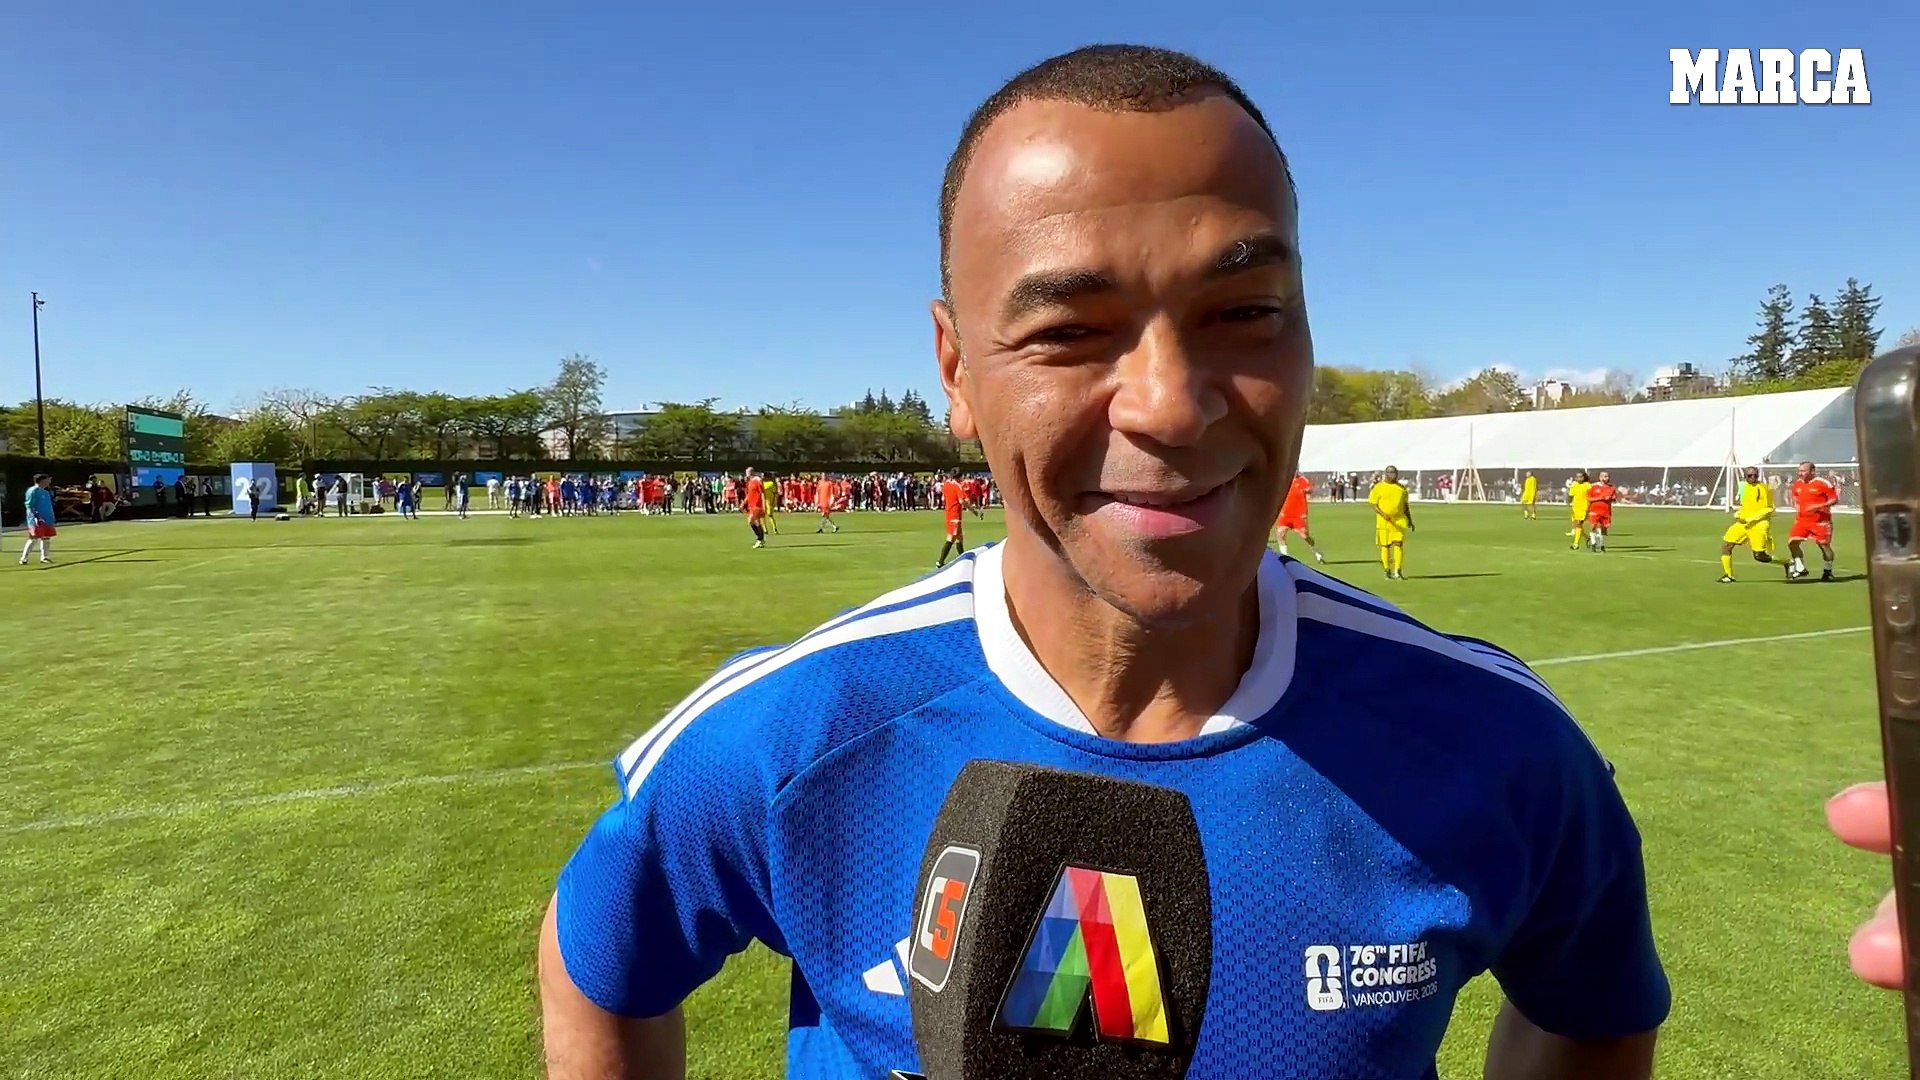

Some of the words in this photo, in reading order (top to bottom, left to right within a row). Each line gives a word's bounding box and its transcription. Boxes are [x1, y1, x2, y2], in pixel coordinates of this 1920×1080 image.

[1388, 941, 1428, 964] FIFA
[1350, 957, 1437, 987] CONGRESS
[1318, 995, 1335, 1004] FIFA
[1352, 988, 1420, 1007] VANCOUVER
[1421, 981, 1438, 998] 2026
